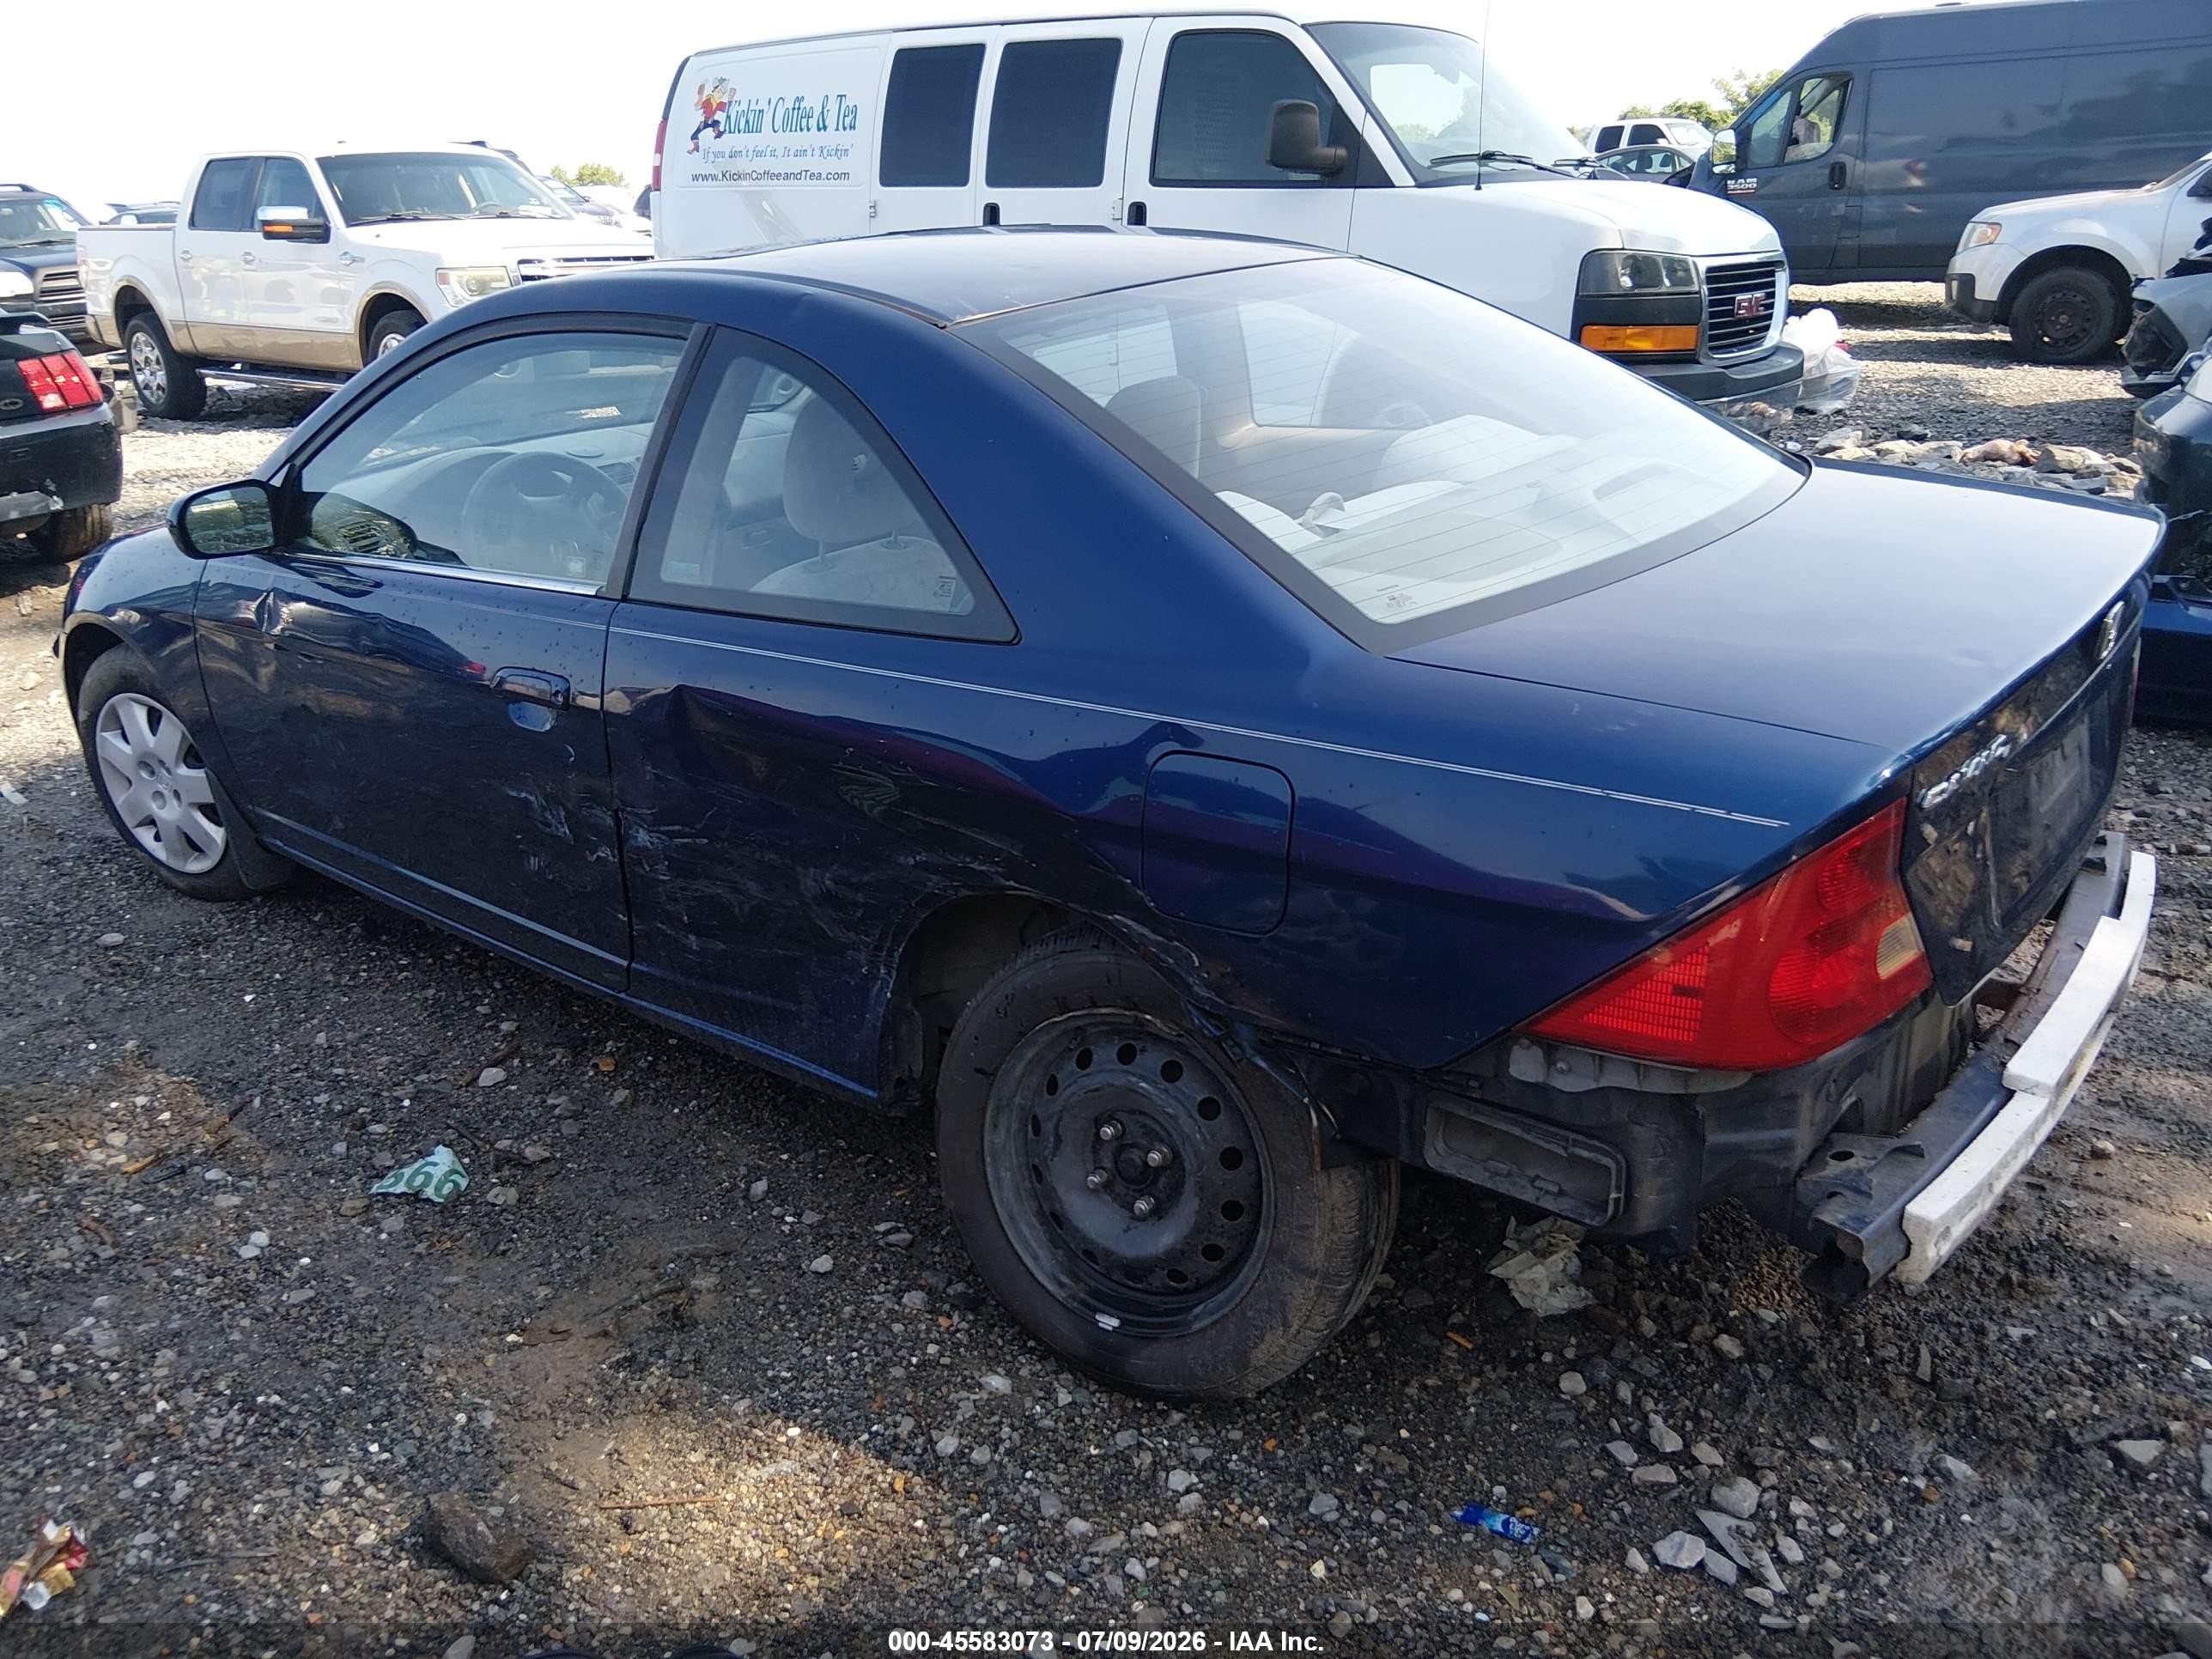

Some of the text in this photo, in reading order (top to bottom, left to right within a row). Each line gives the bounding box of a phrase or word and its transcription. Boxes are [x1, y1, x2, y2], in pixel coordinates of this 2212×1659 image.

[724, 94, 858, 134] Kickin' Coffee & Tea
[702, 146, 711, 164] If
[711, 149, 726, 163] you
[728, 145, 749, 159] don't
[749, 144, 769, 162] feel
[782, 146, 790, 158] It
[793, 143, 815, 158] ain't
[818, 143, 854, 160] Kickin'
[691, 169, 850, 182] www.KickinCoffeeandTea.com
